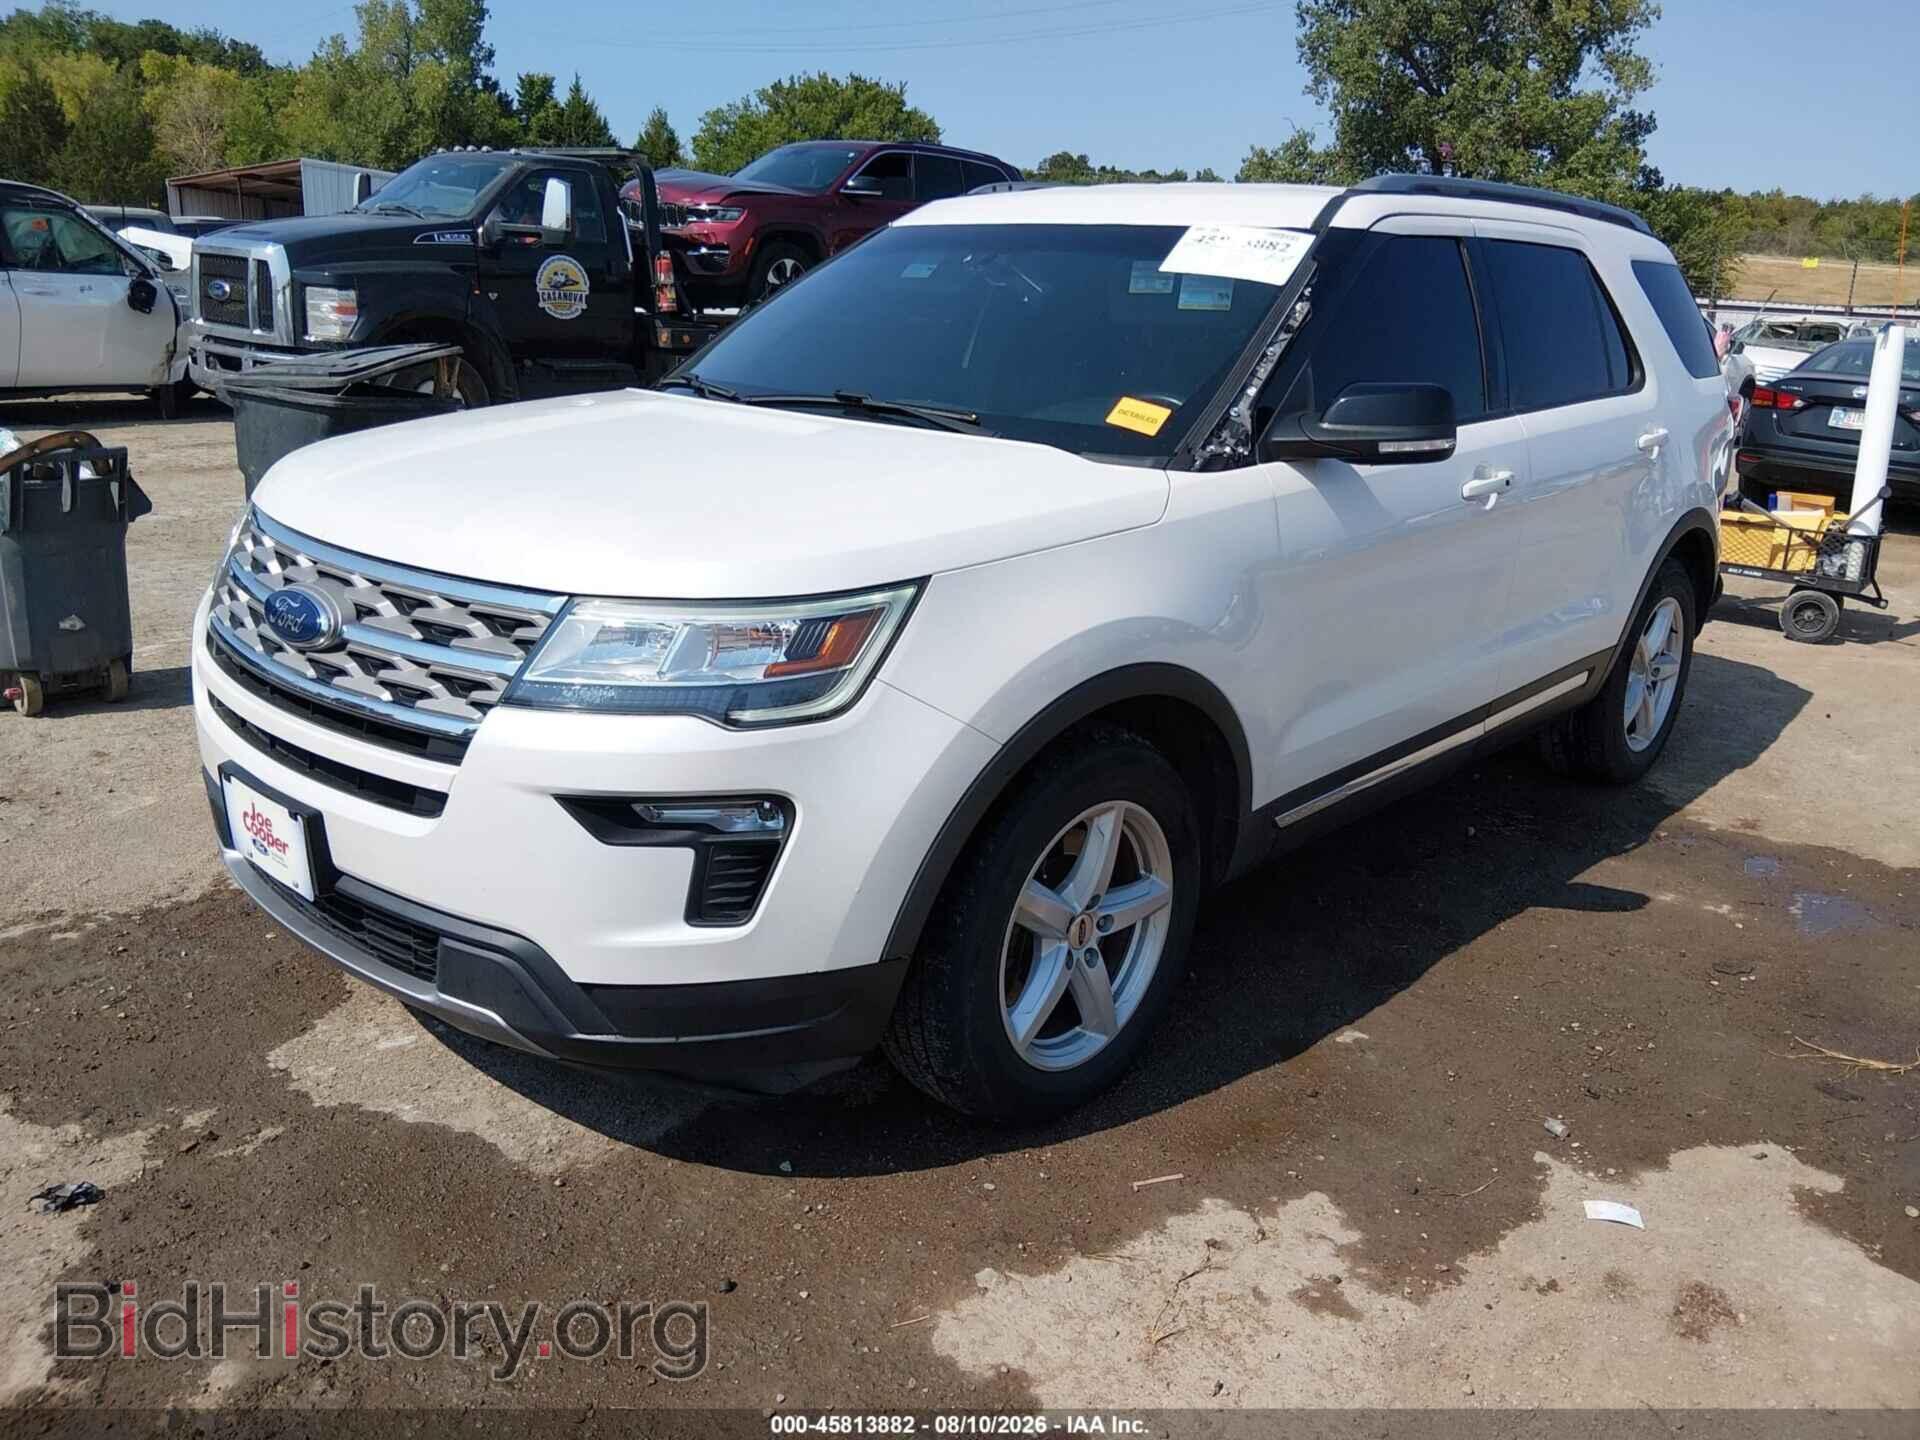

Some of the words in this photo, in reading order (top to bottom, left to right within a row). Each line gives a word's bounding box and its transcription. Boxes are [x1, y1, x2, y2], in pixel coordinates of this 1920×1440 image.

[541, 291, 584, 304] CASANOVA
[1117, 408, 1159, 425] DETAILED
[269, 596, 307, 633] Ford
[242, 810, 290, 855] Cooper
[250, 801, 273, 833] Joe
